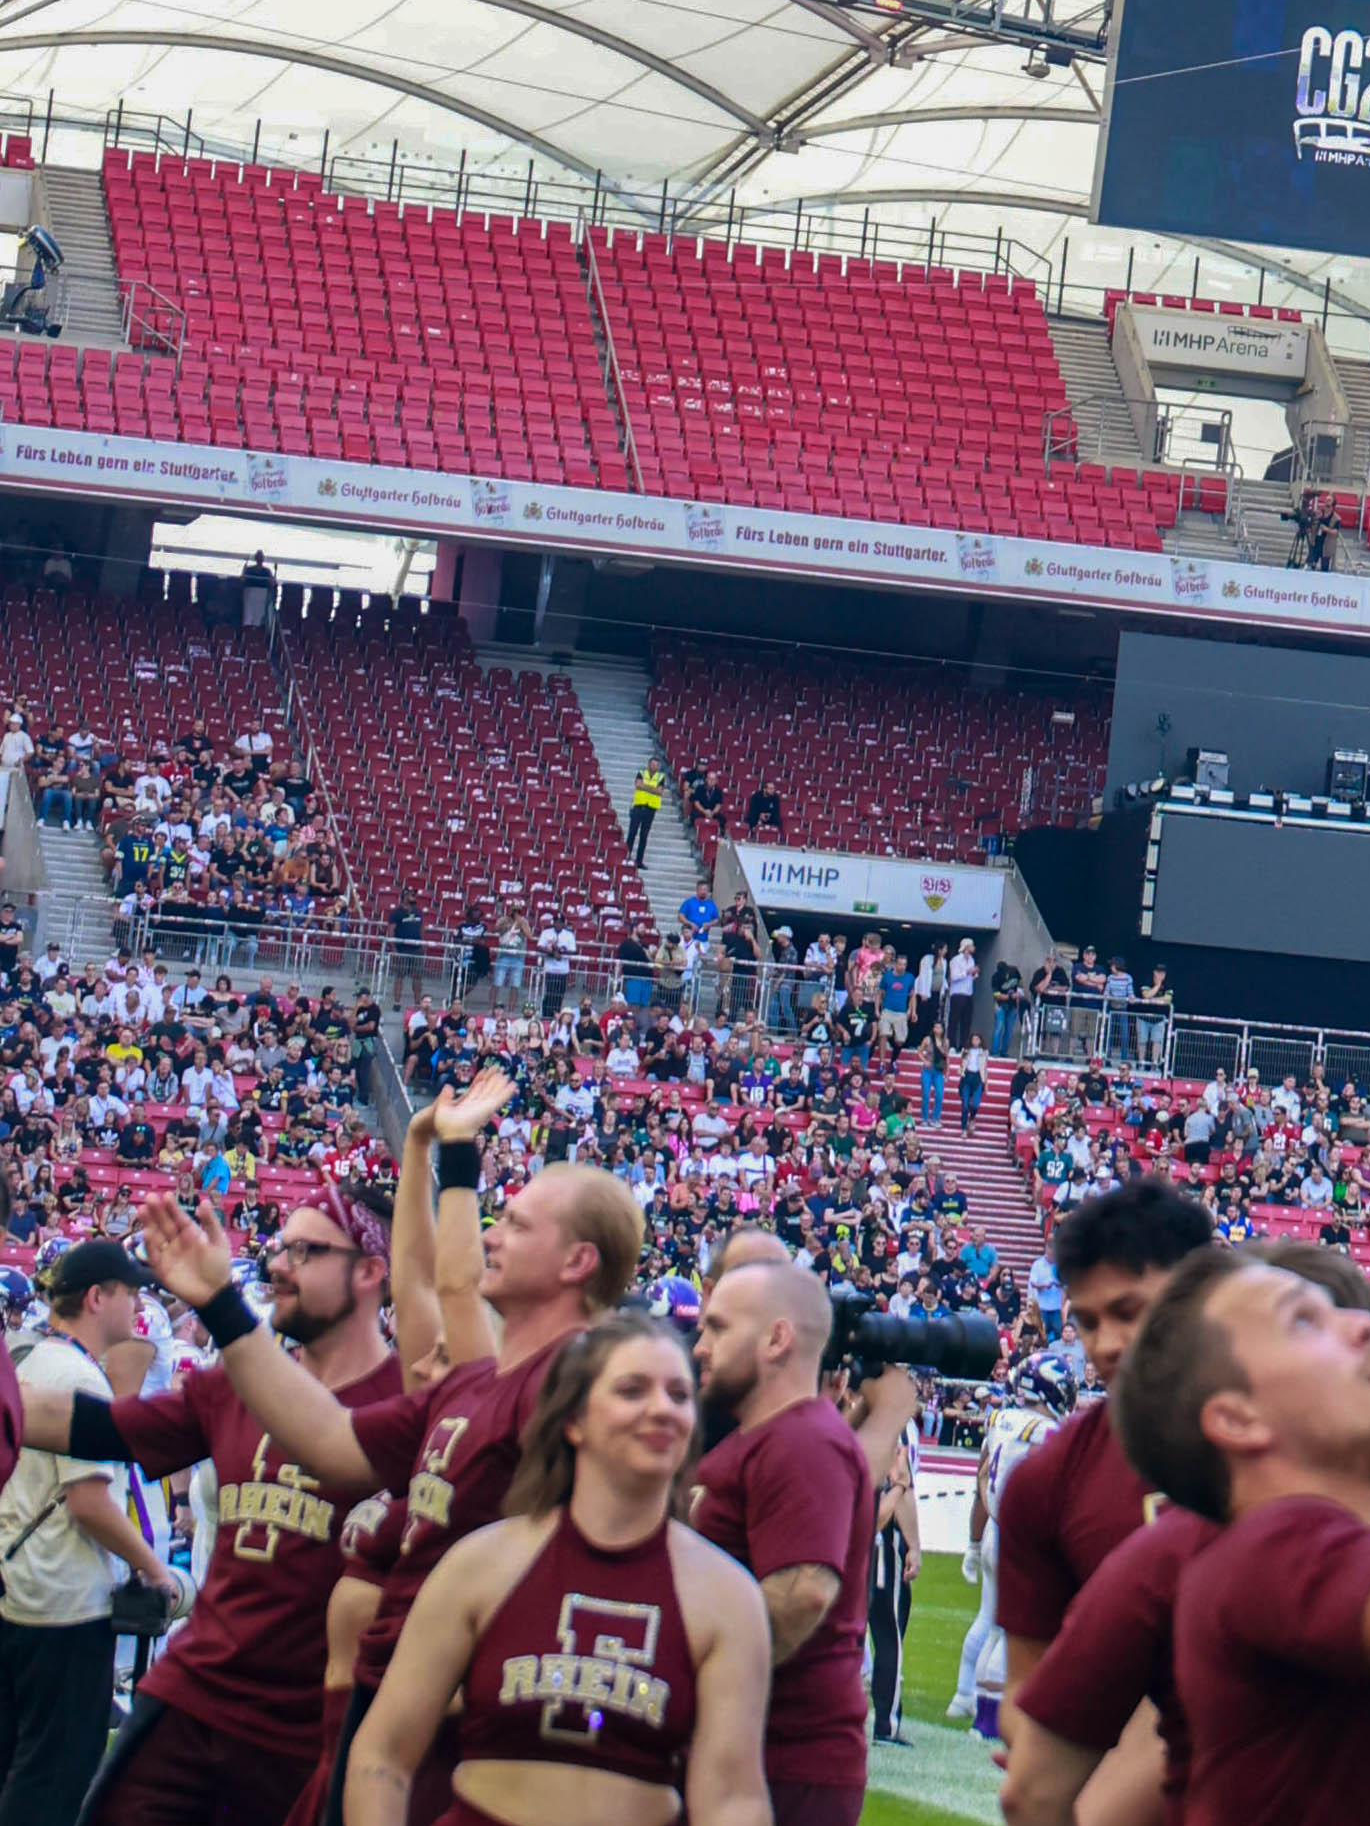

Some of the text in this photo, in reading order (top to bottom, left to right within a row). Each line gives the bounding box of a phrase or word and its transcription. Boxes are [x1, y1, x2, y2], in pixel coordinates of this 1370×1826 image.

[1173, 333, 1269, 358] MHP Arena
[16, 444, 46, 462] Fürs
[97, 456, 128, 472] gern
[341, 482, 462, 508] Stuttgarter Hofbräu
[546, 506, 665, 533] Stuttgarter Hofbräu
[736, 525, 948, 563] Fürs Leben gern ein Stuttgarter.
[1046, 562, 1162, 589] Stuttgarter Hofbräu
[1243, 584, 1358, 611] Stuttgarter Hofbräu
[786, 863, 840, 888] MHP
[219, 1482, 335, 1541] RHEIN
